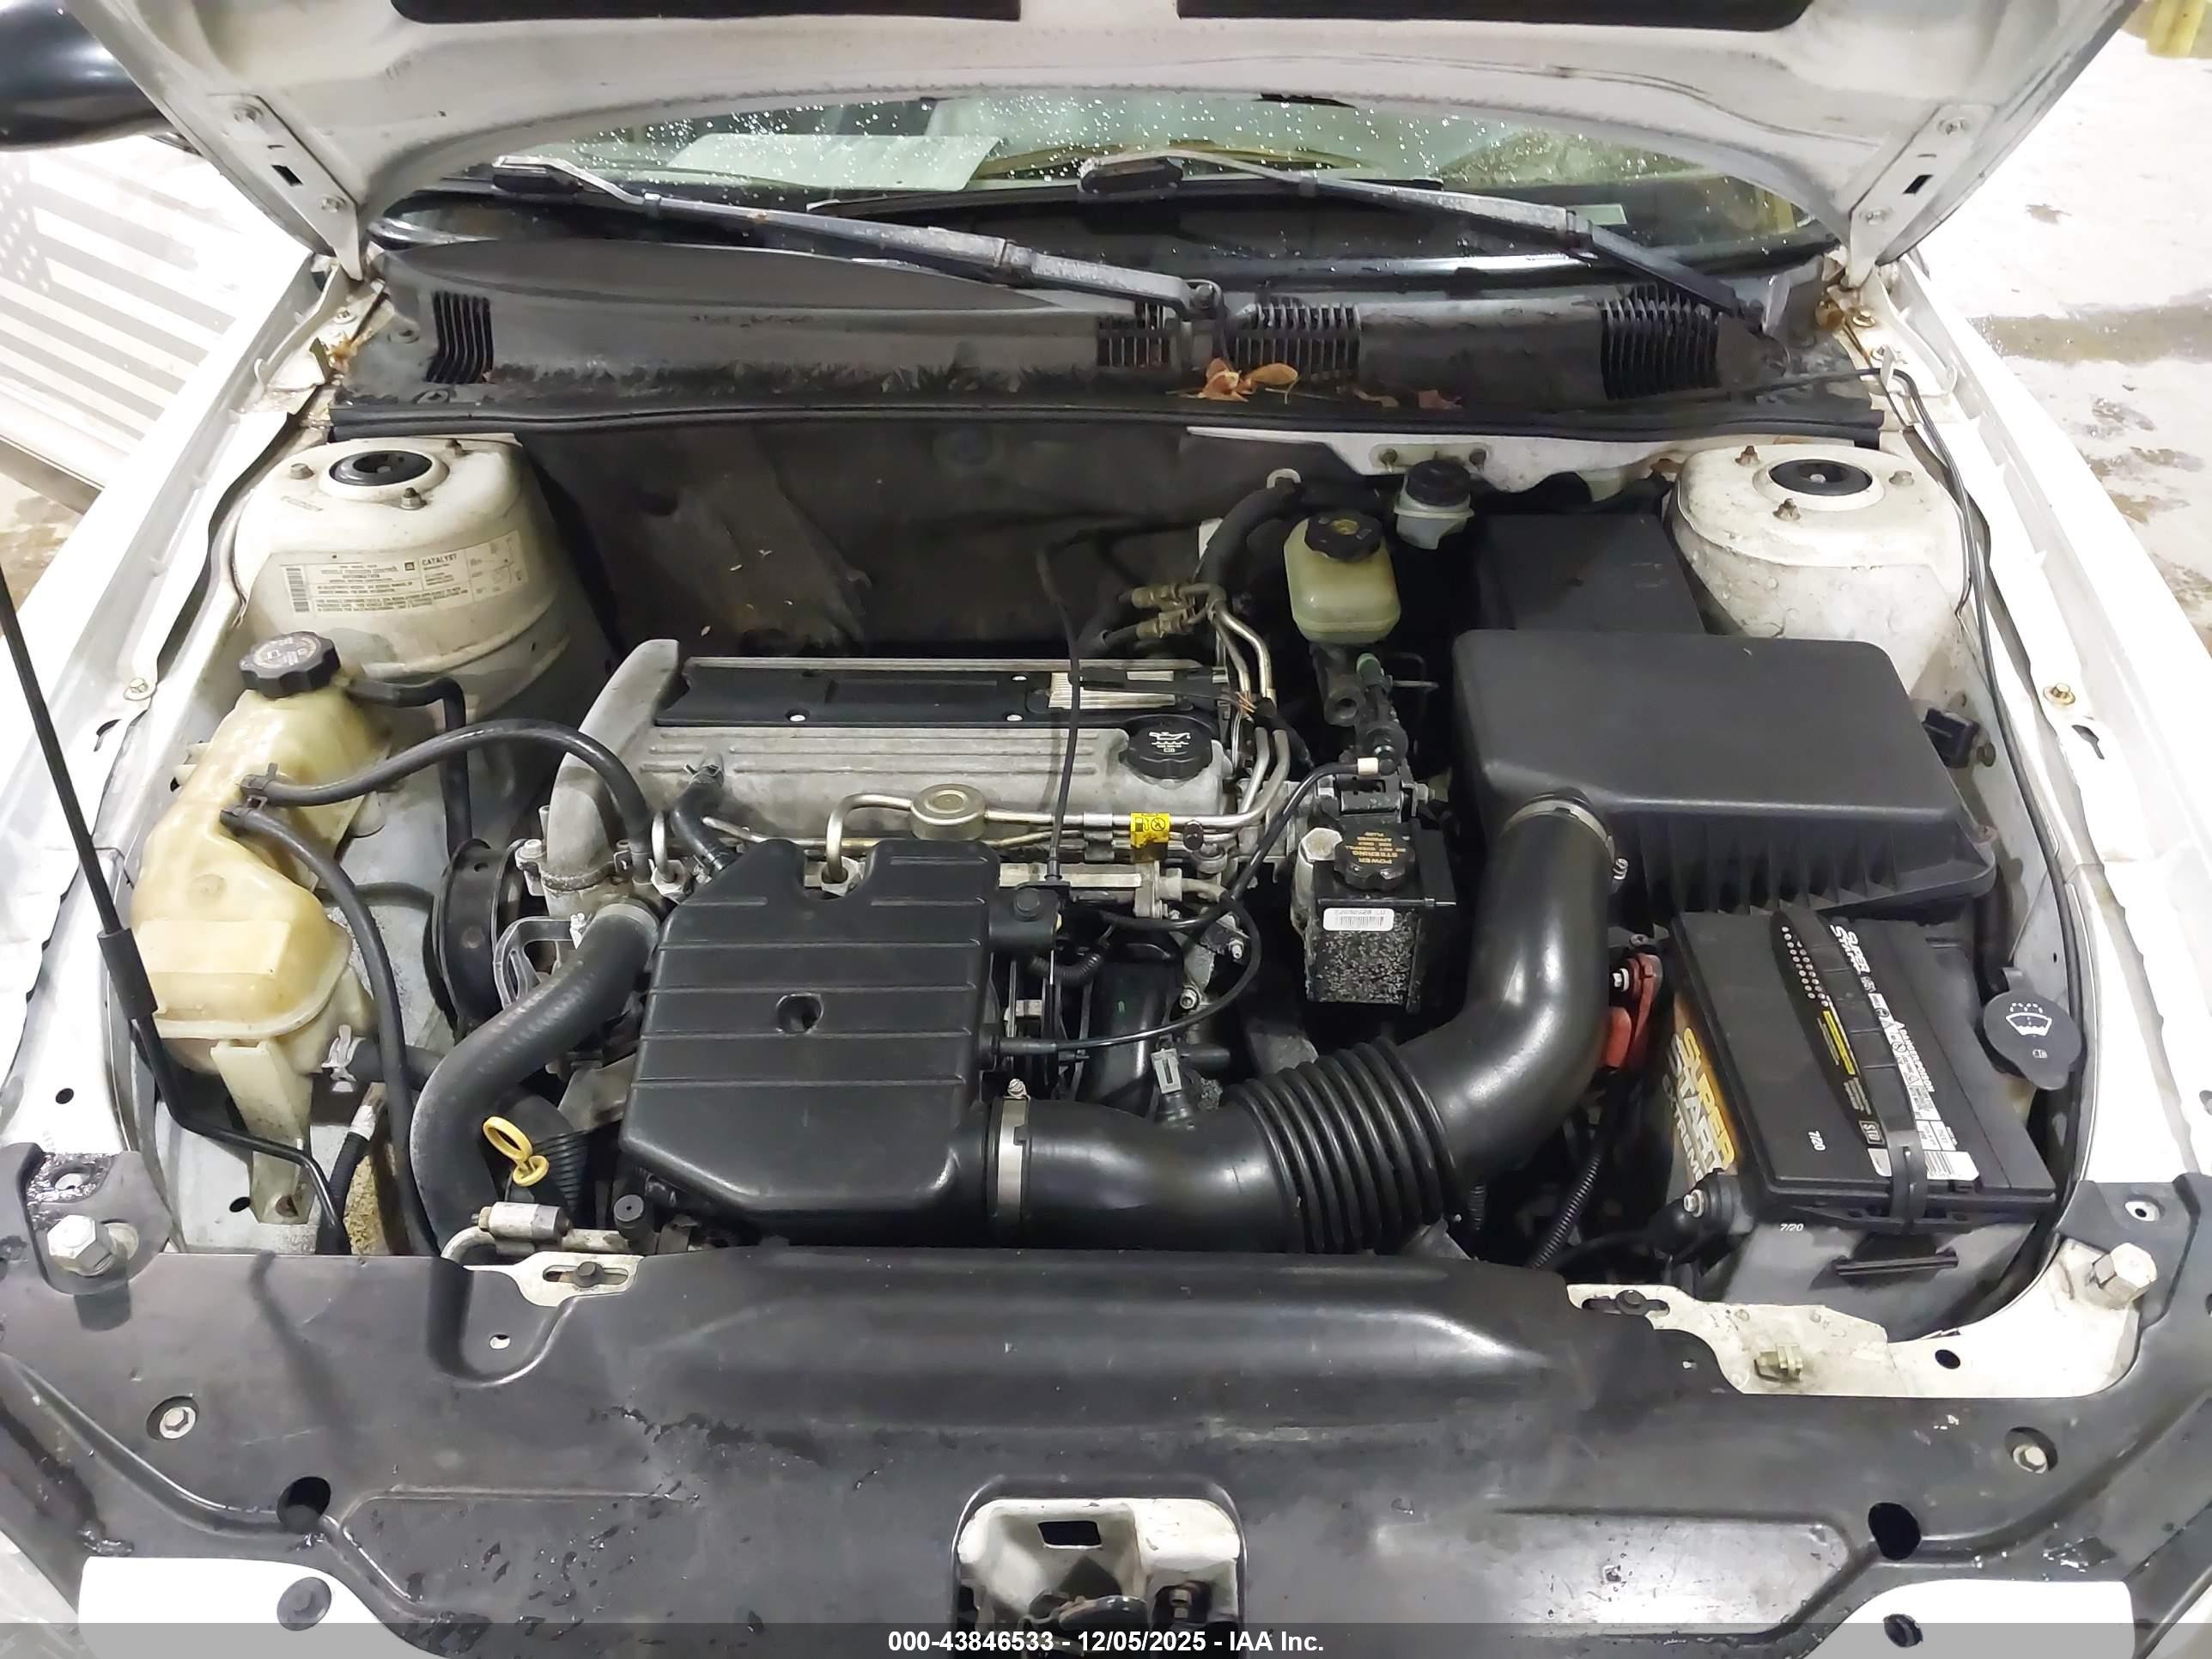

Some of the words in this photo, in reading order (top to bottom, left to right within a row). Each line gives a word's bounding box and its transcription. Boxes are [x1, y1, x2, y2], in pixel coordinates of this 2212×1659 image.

[1847, 931, 1871, 973] SUPER
[1668, 1033, 1724, 1174] START
[1683, 1027, 1735, 1170] SUPER
[1808, 1130, 1826, 1151] 7/20
[1780, 1223, 1804, 1231] 7/20
